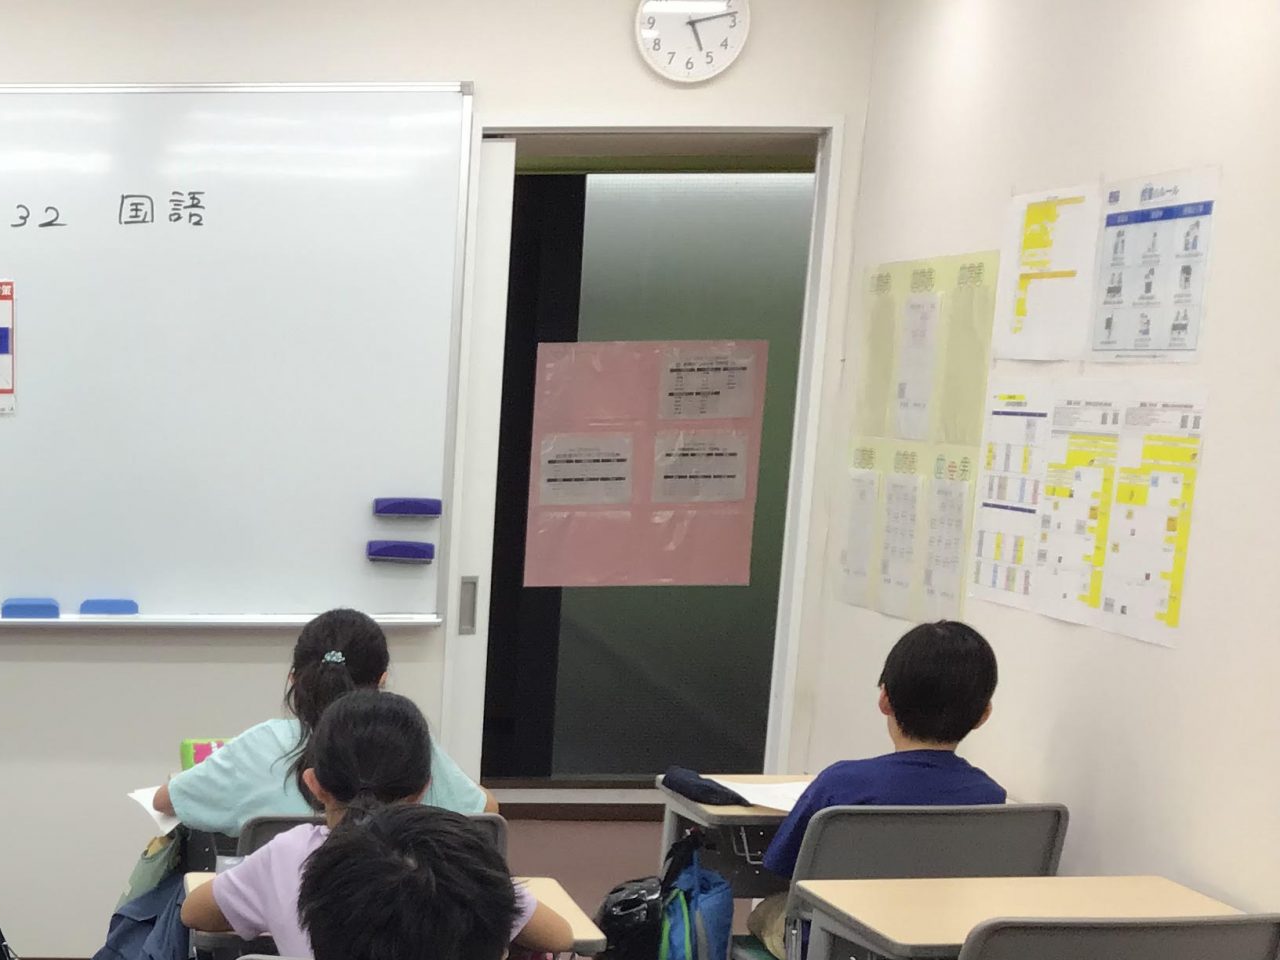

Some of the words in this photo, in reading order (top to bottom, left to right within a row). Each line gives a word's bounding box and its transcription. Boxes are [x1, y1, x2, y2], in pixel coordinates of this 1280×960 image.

[647, 16, 656, 29] 9
[729, 14, 737, 28] 3
[652, 38, 661, 51] 8
[720, 37, 728, 49] 4
[667, 51, 676, 65] 7
[685, 57, 694, 70] 6
[705, 51, 714, 64] 5
[119, 191, 206, 226] 国語
